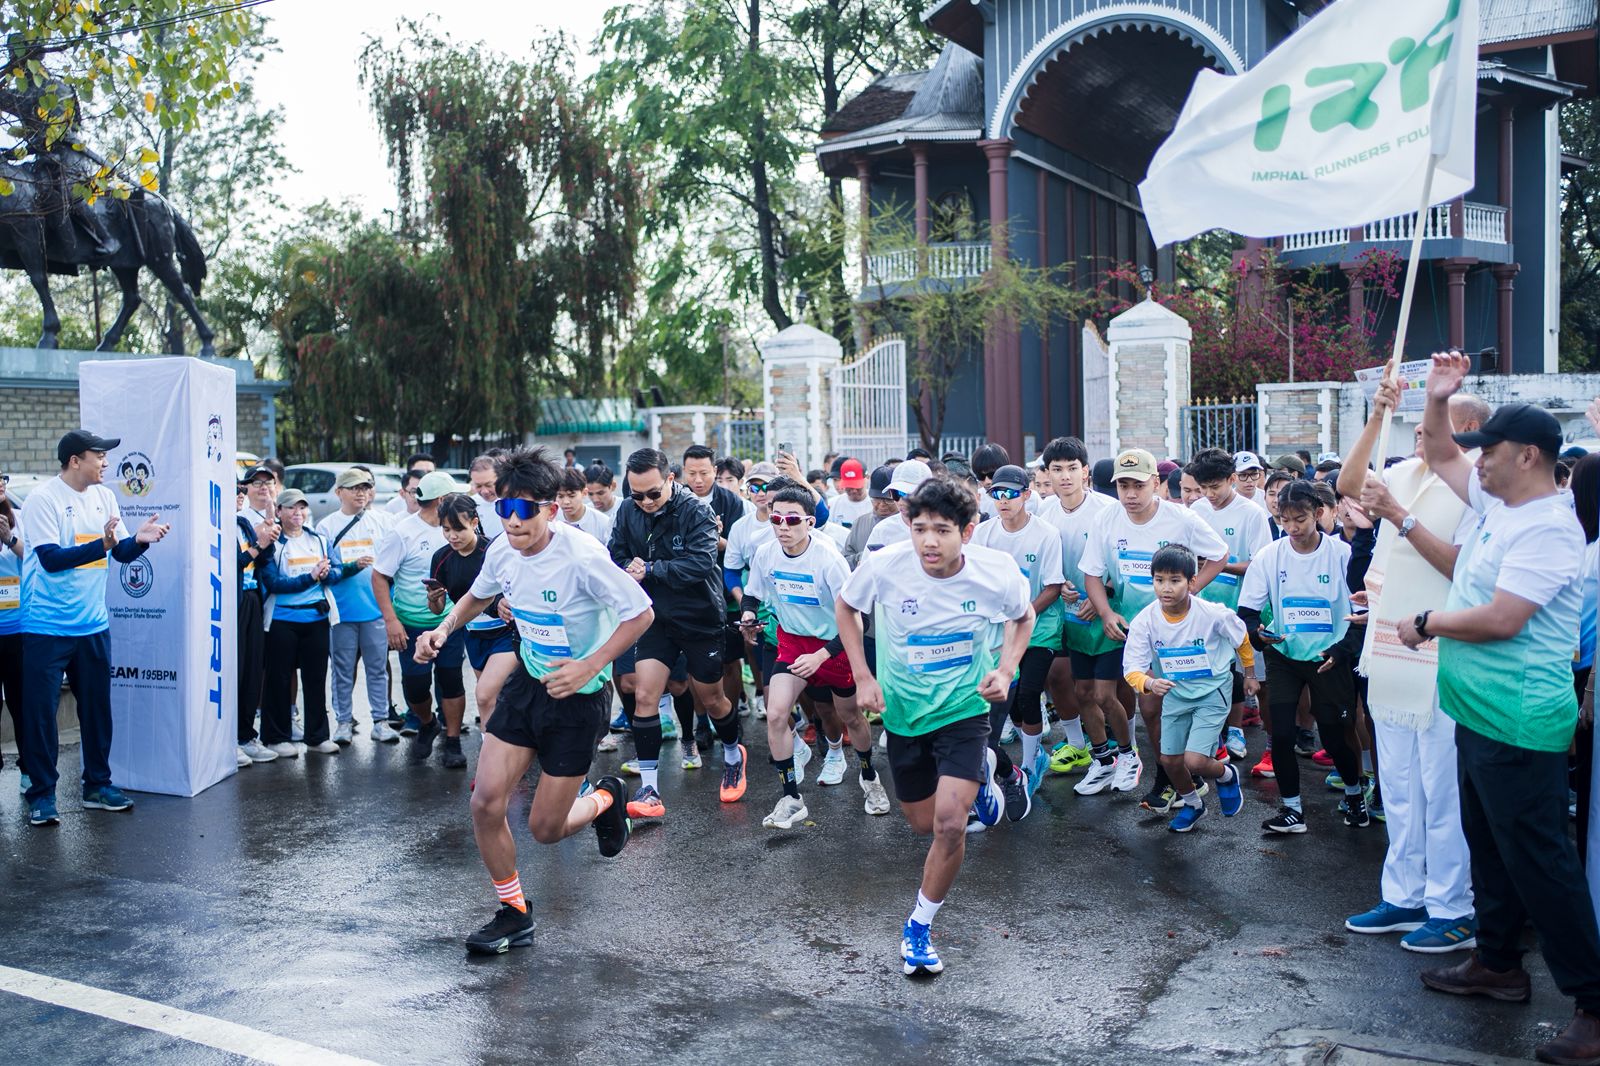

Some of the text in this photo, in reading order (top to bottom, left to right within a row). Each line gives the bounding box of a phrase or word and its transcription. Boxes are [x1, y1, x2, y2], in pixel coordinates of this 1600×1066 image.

[1251, 170, 1308, 182] IMPHAL
[1313, 142, 1391, 178] RUNNERS
[209, 480, 222, 719] START
[529, 626, 551, 637] 10122
[931, 646, 955, 655] 10141
[109, 666, 177, 681] EAM 195BPM
